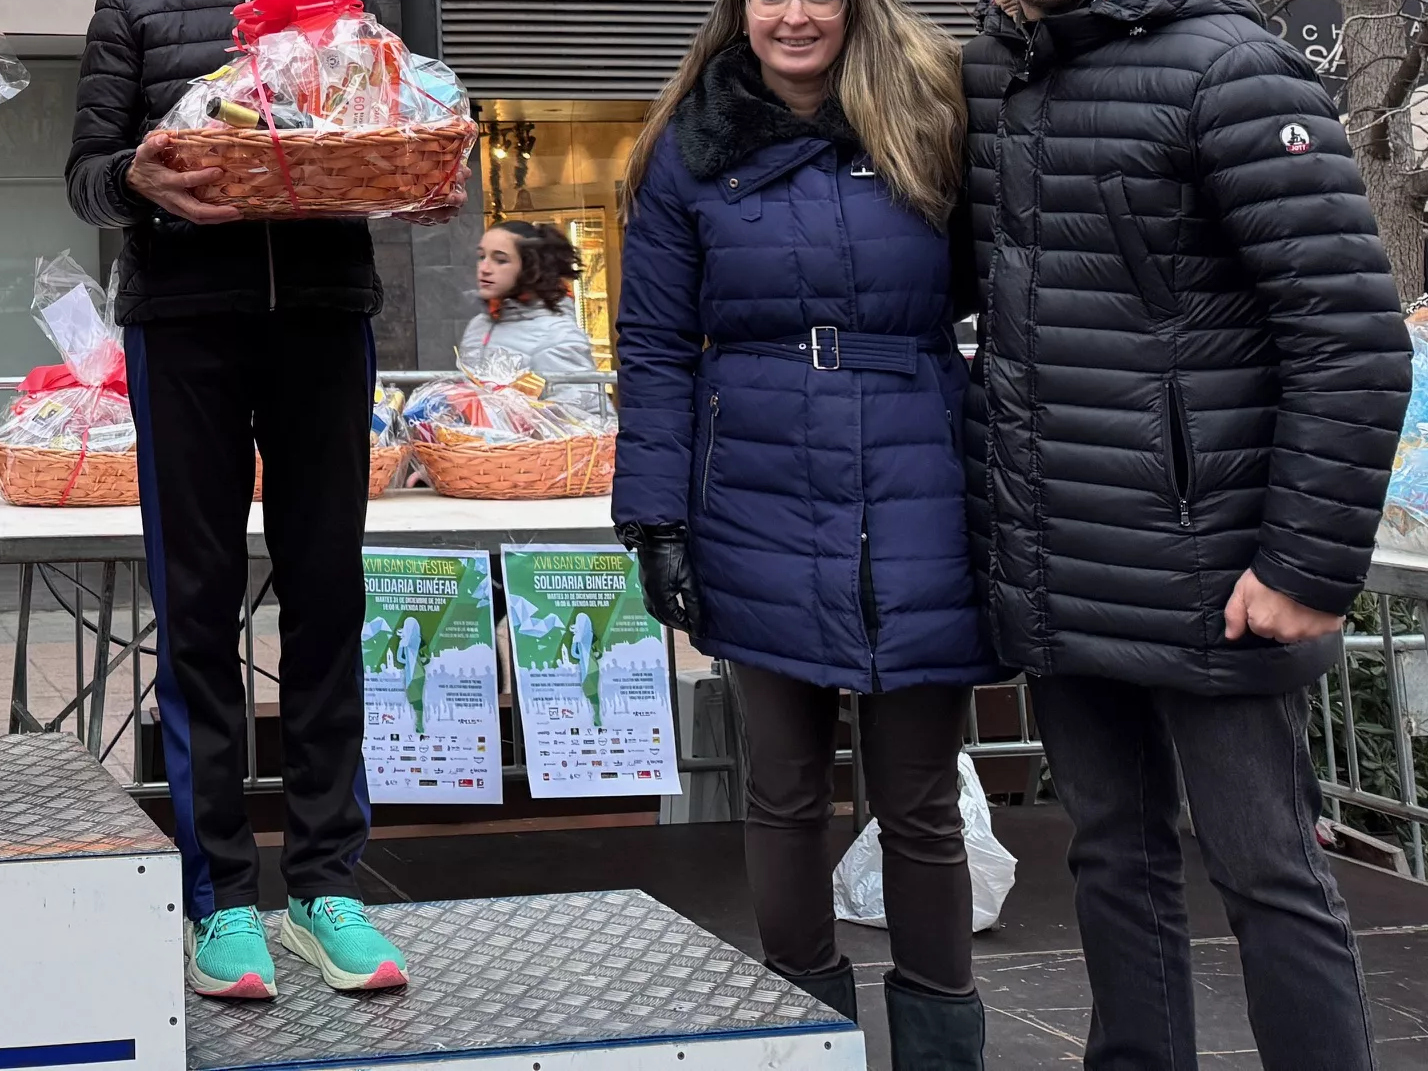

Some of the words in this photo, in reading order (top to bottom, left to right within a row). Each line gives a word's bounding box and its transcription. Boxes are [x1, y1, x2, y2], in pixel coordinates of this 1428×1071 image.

[384, 559, 404, 574] SAN
[406, 559, 456, 575] SILVESTRE
[553, 556, 573, 570] SAN
[576, 556, 623, 570] SILVESTRE
[364, 577, 414, 594] SOLIDARIA
[417, 577, 458, 595] BINÉFAR
[534, 575, 584, 590] SOLIDARIA
[586, 574, 626, 590] BINÉFAR
